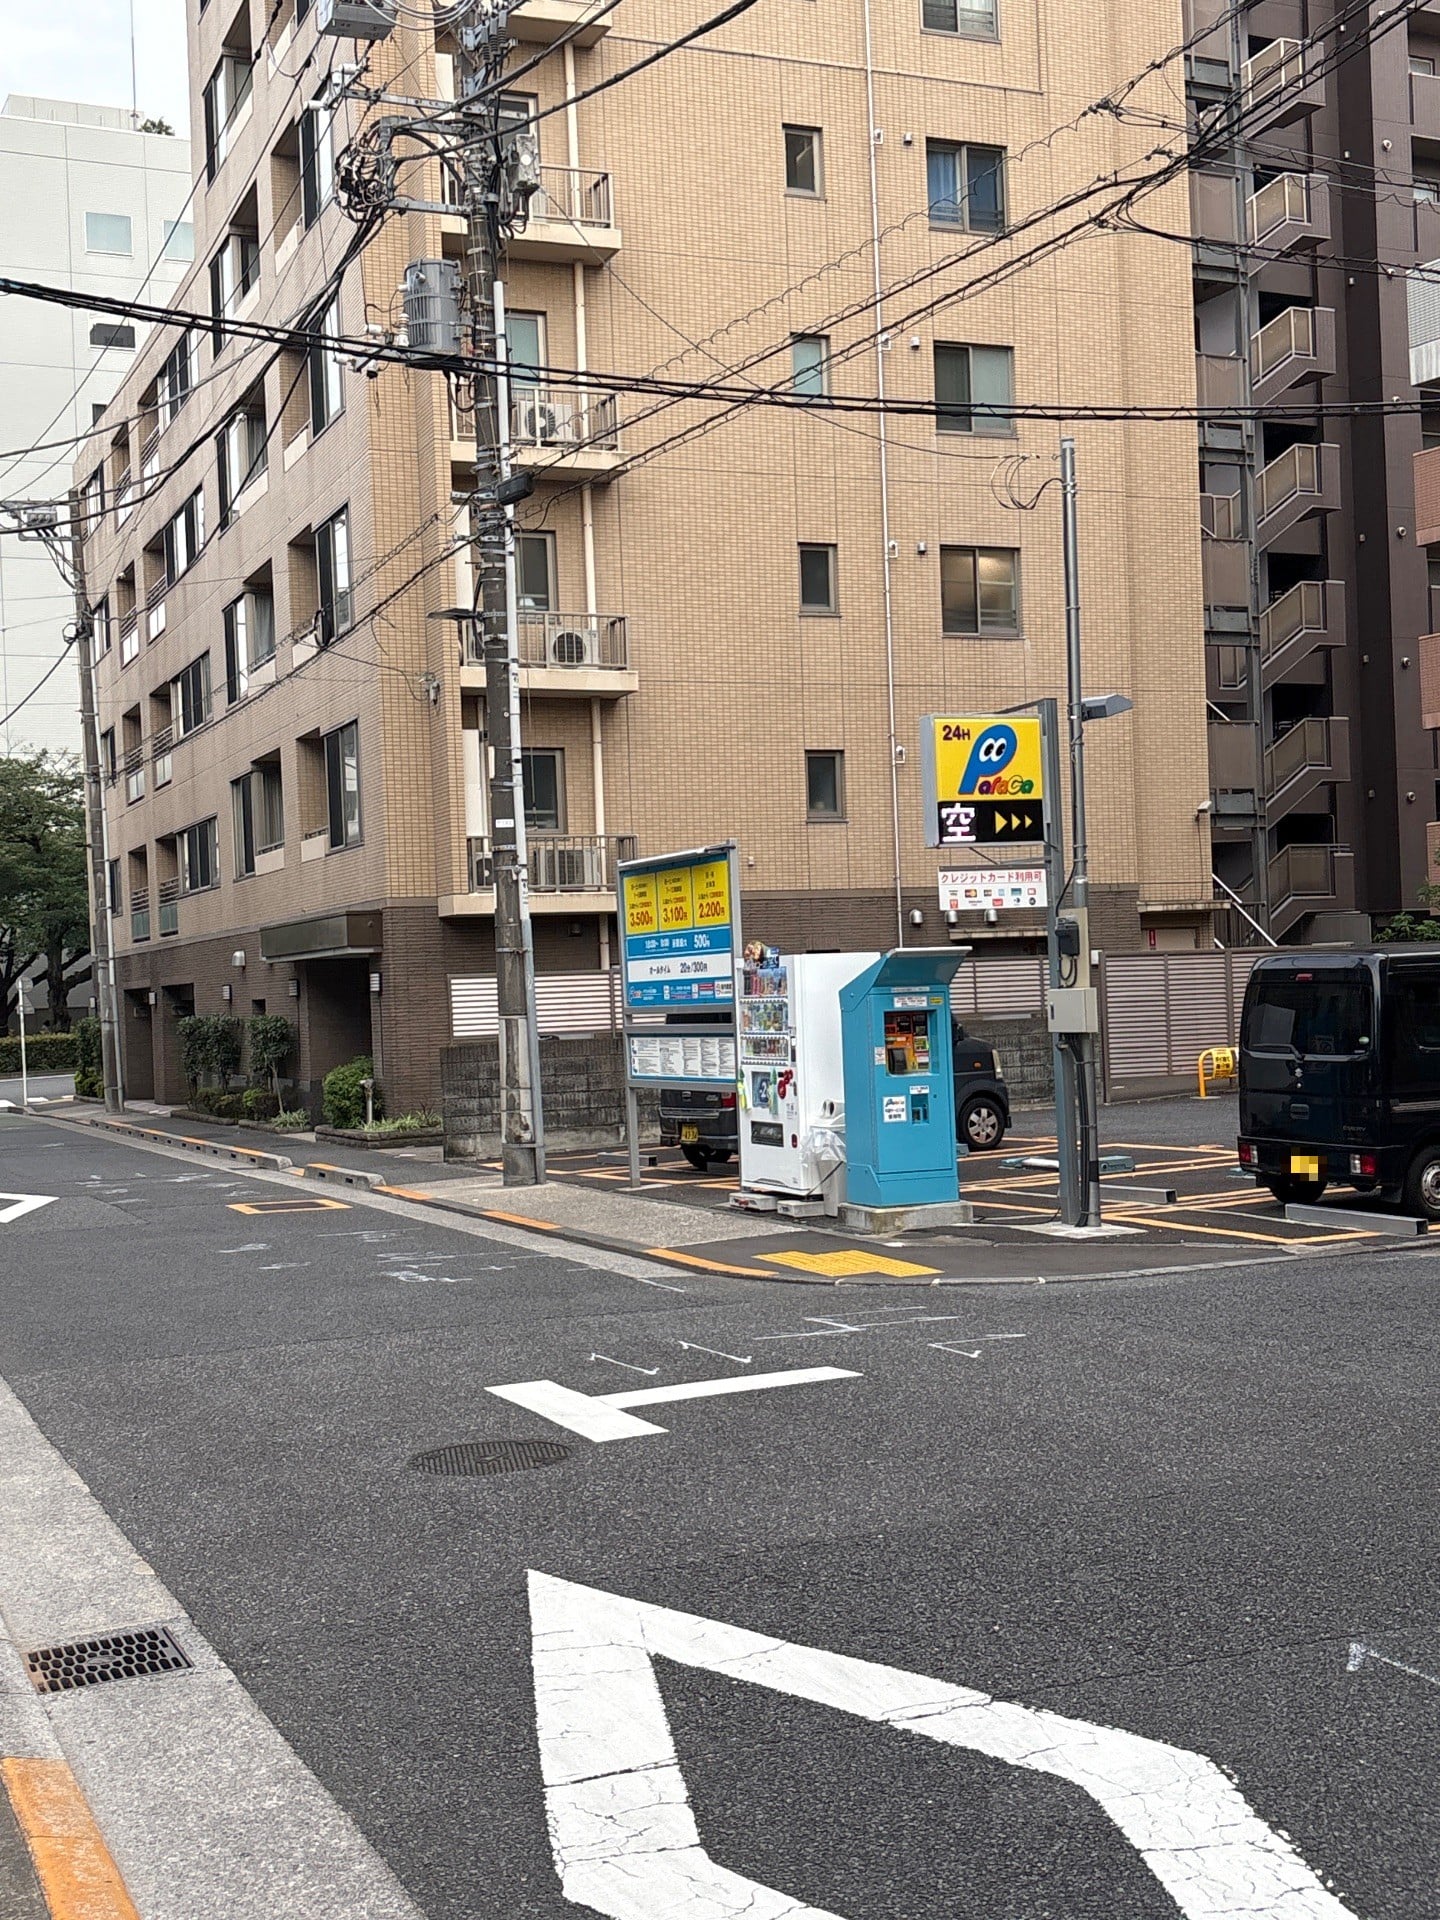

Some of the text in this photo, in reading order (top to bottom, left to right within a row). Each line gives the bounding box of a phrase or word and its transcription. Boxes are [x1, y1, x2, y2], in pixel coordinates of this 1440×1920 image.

[942, 724, 971, 741] 24H
[941, 802, 976, 843] 空
[941, 870, 1043, 884] クレジットカード利用可
